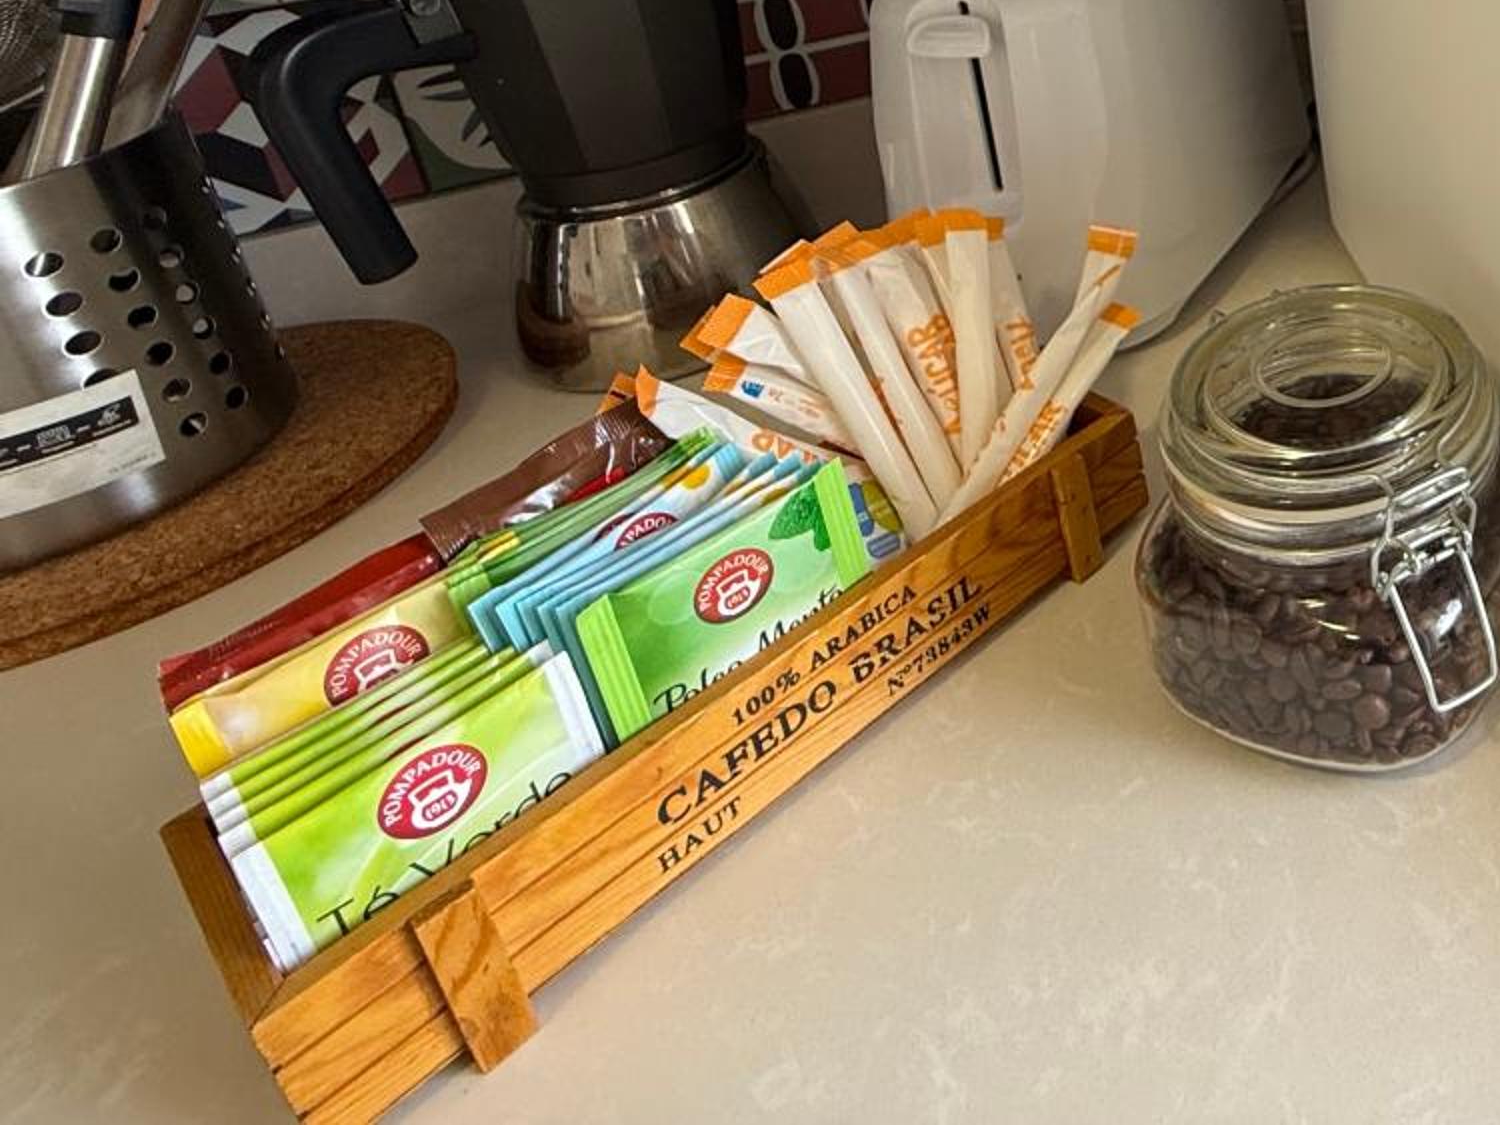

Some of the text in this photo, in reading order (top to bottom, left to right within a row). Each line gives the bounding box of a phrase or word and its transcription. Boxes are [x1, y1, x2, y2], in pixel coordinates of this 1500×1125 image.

[697, 553, 769, 613] POMPADOUR
[329, 631, 422, 698] POMPADOUR
[730, 586, 917, 725] 100% ARABICA
[848, 576, 983, 684] BRASIL
[383, 749, 481, 827] POMPADOUR
[657, 797, 742, 873] HAUT
